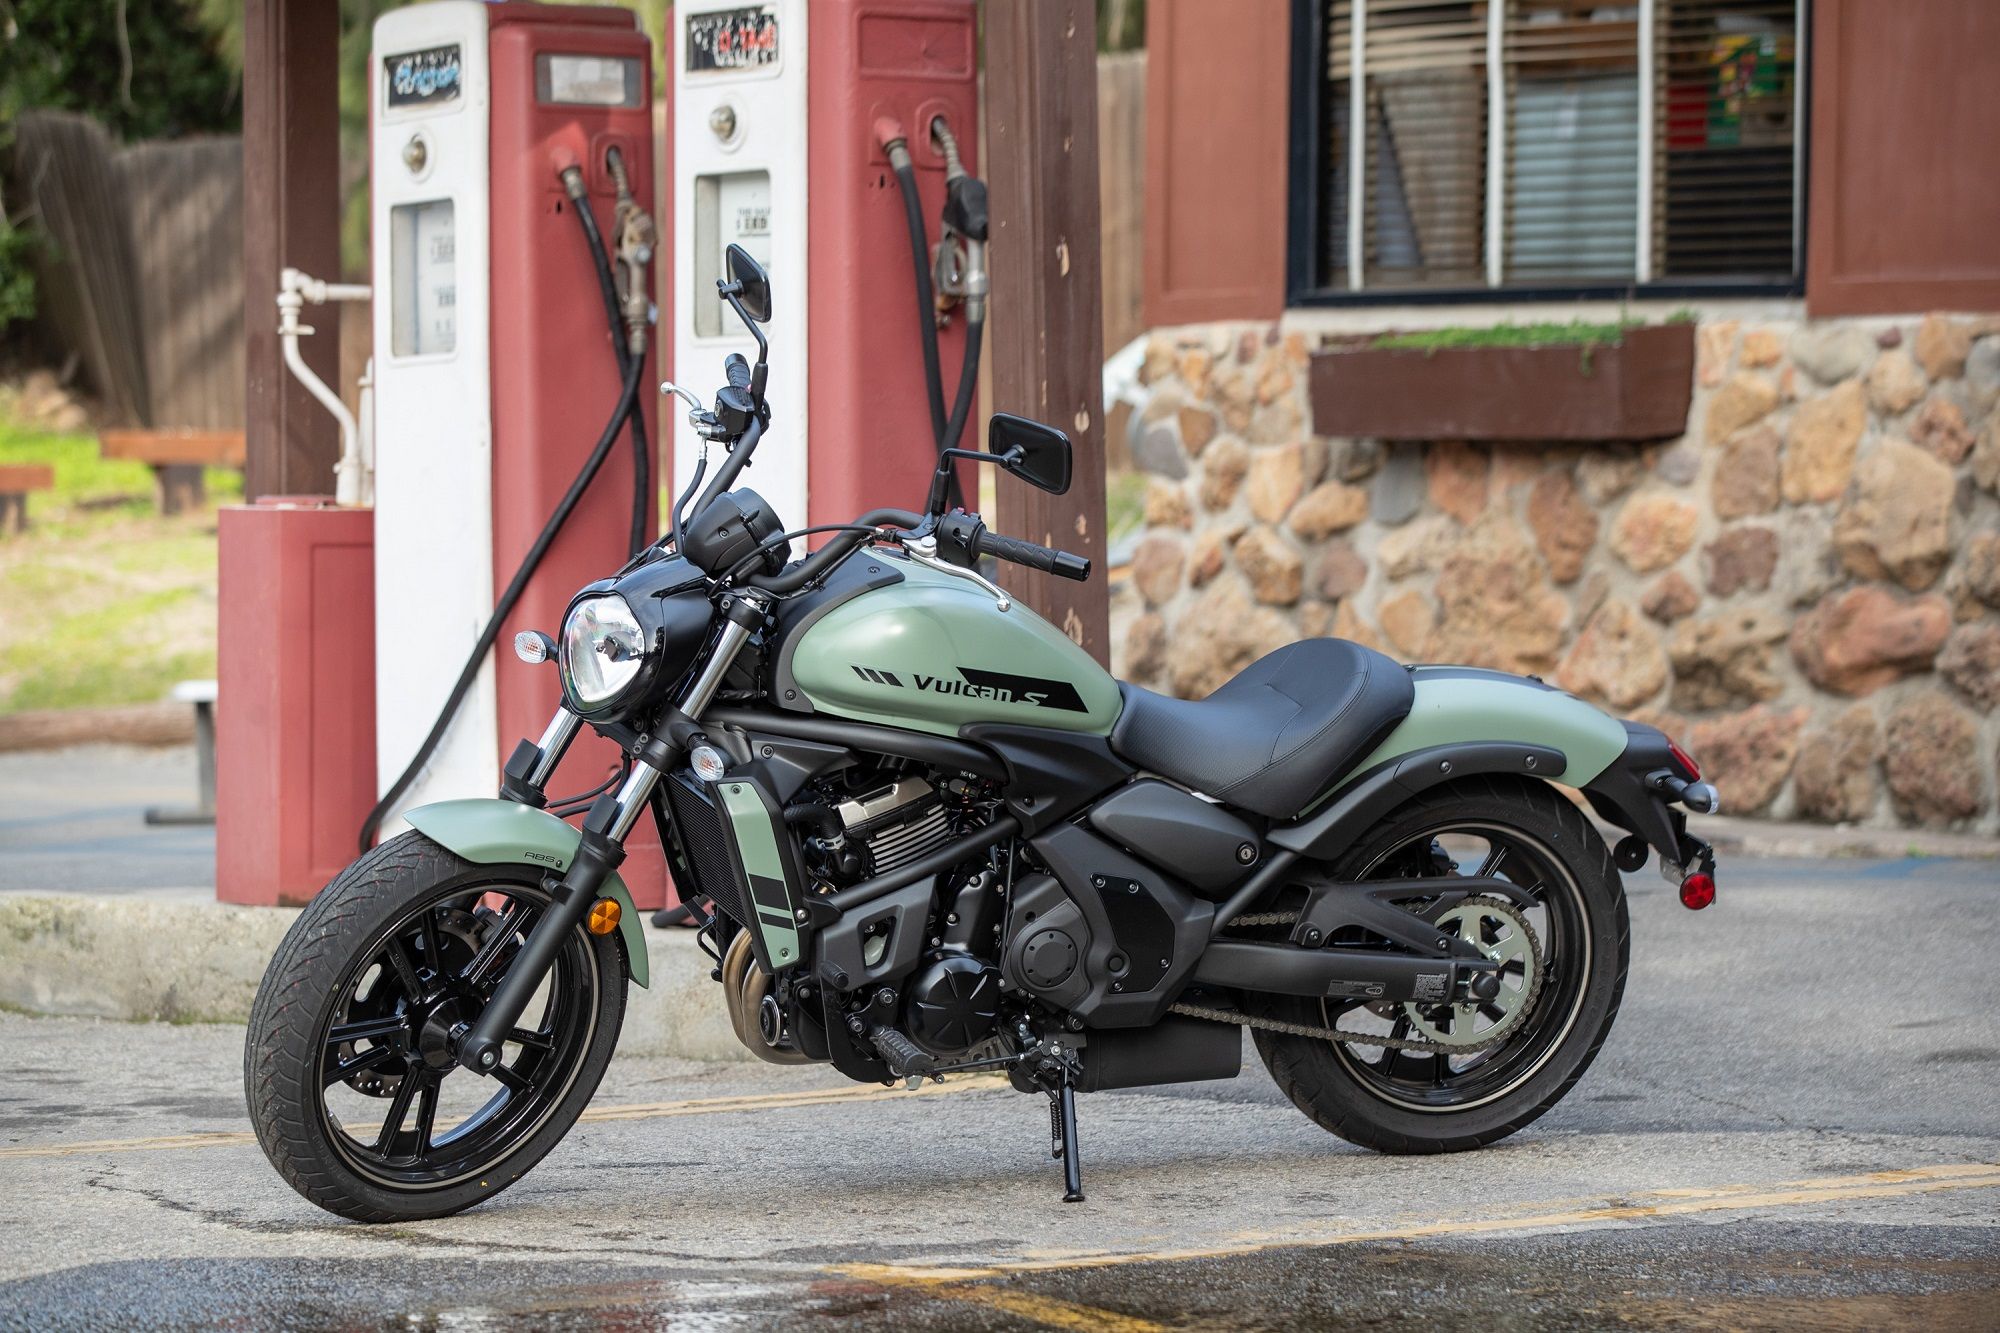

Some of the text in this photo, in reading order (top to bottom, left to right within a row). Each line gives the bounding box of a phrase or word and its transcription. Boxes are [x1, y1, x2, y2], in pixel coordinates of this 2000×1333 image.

[912, 673, 1049, 707] Vulcan S
[524, 851, 556, 863] ABS
